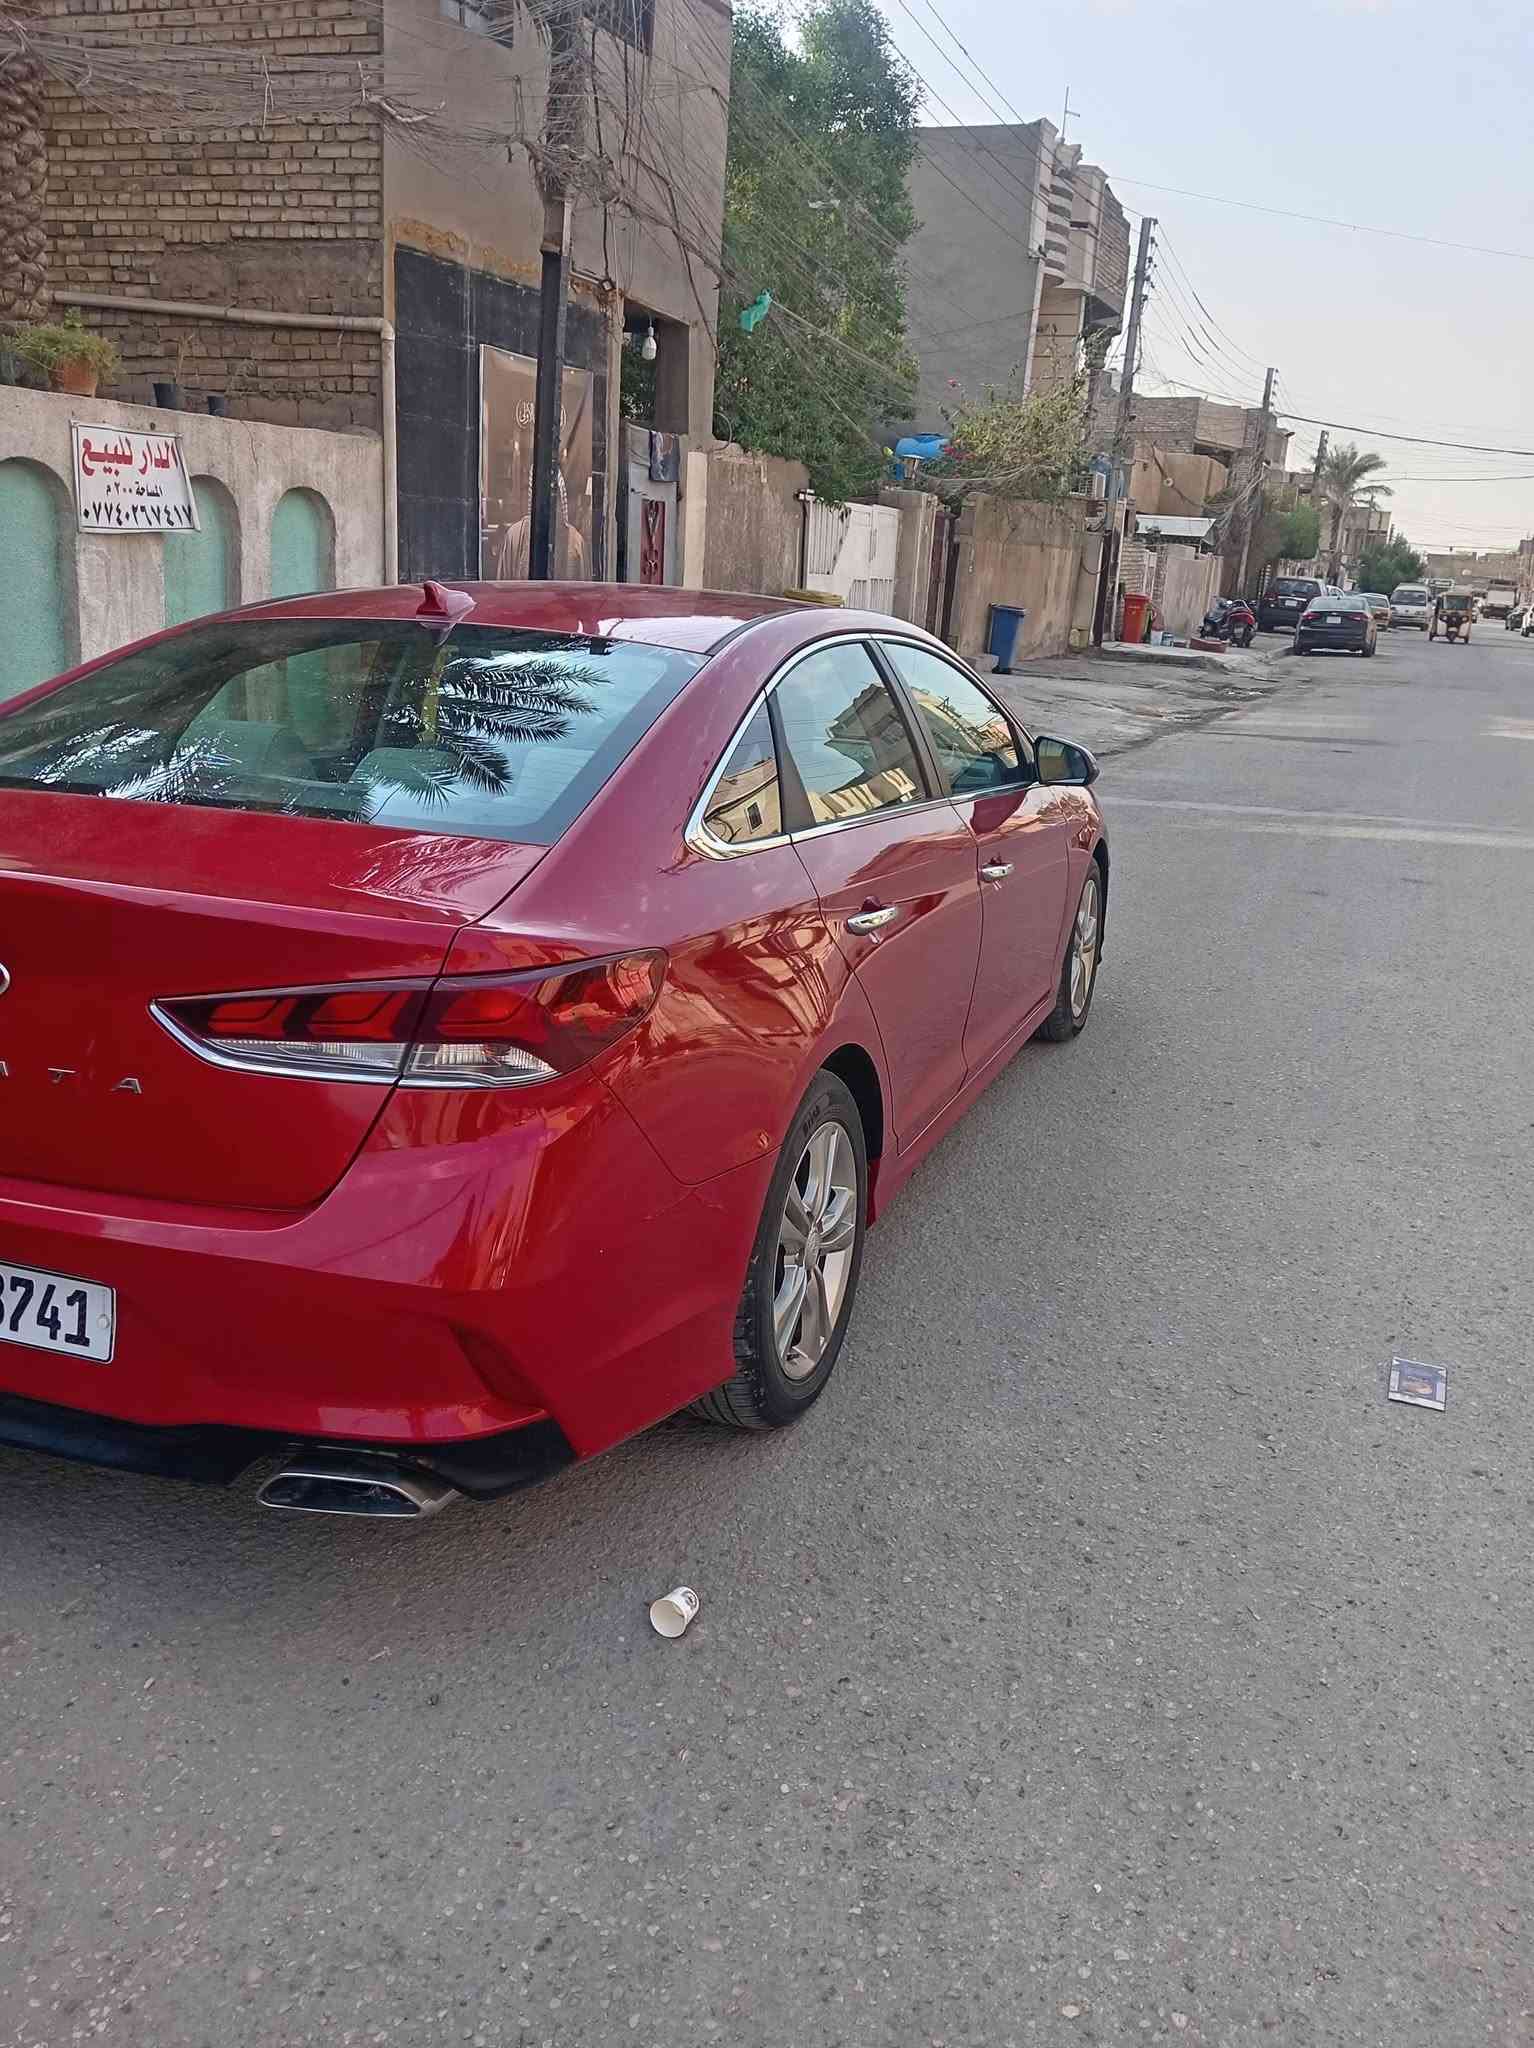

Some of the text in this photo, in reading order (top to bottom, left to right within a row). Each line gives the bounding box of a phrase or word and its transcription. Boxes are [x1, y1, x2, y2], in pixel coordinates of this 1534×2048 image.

[82, 436, 179, 477] الدار للبيع
[135, 480, 163, 498] المساحة
[0, 1272, 91, 1348] 741
